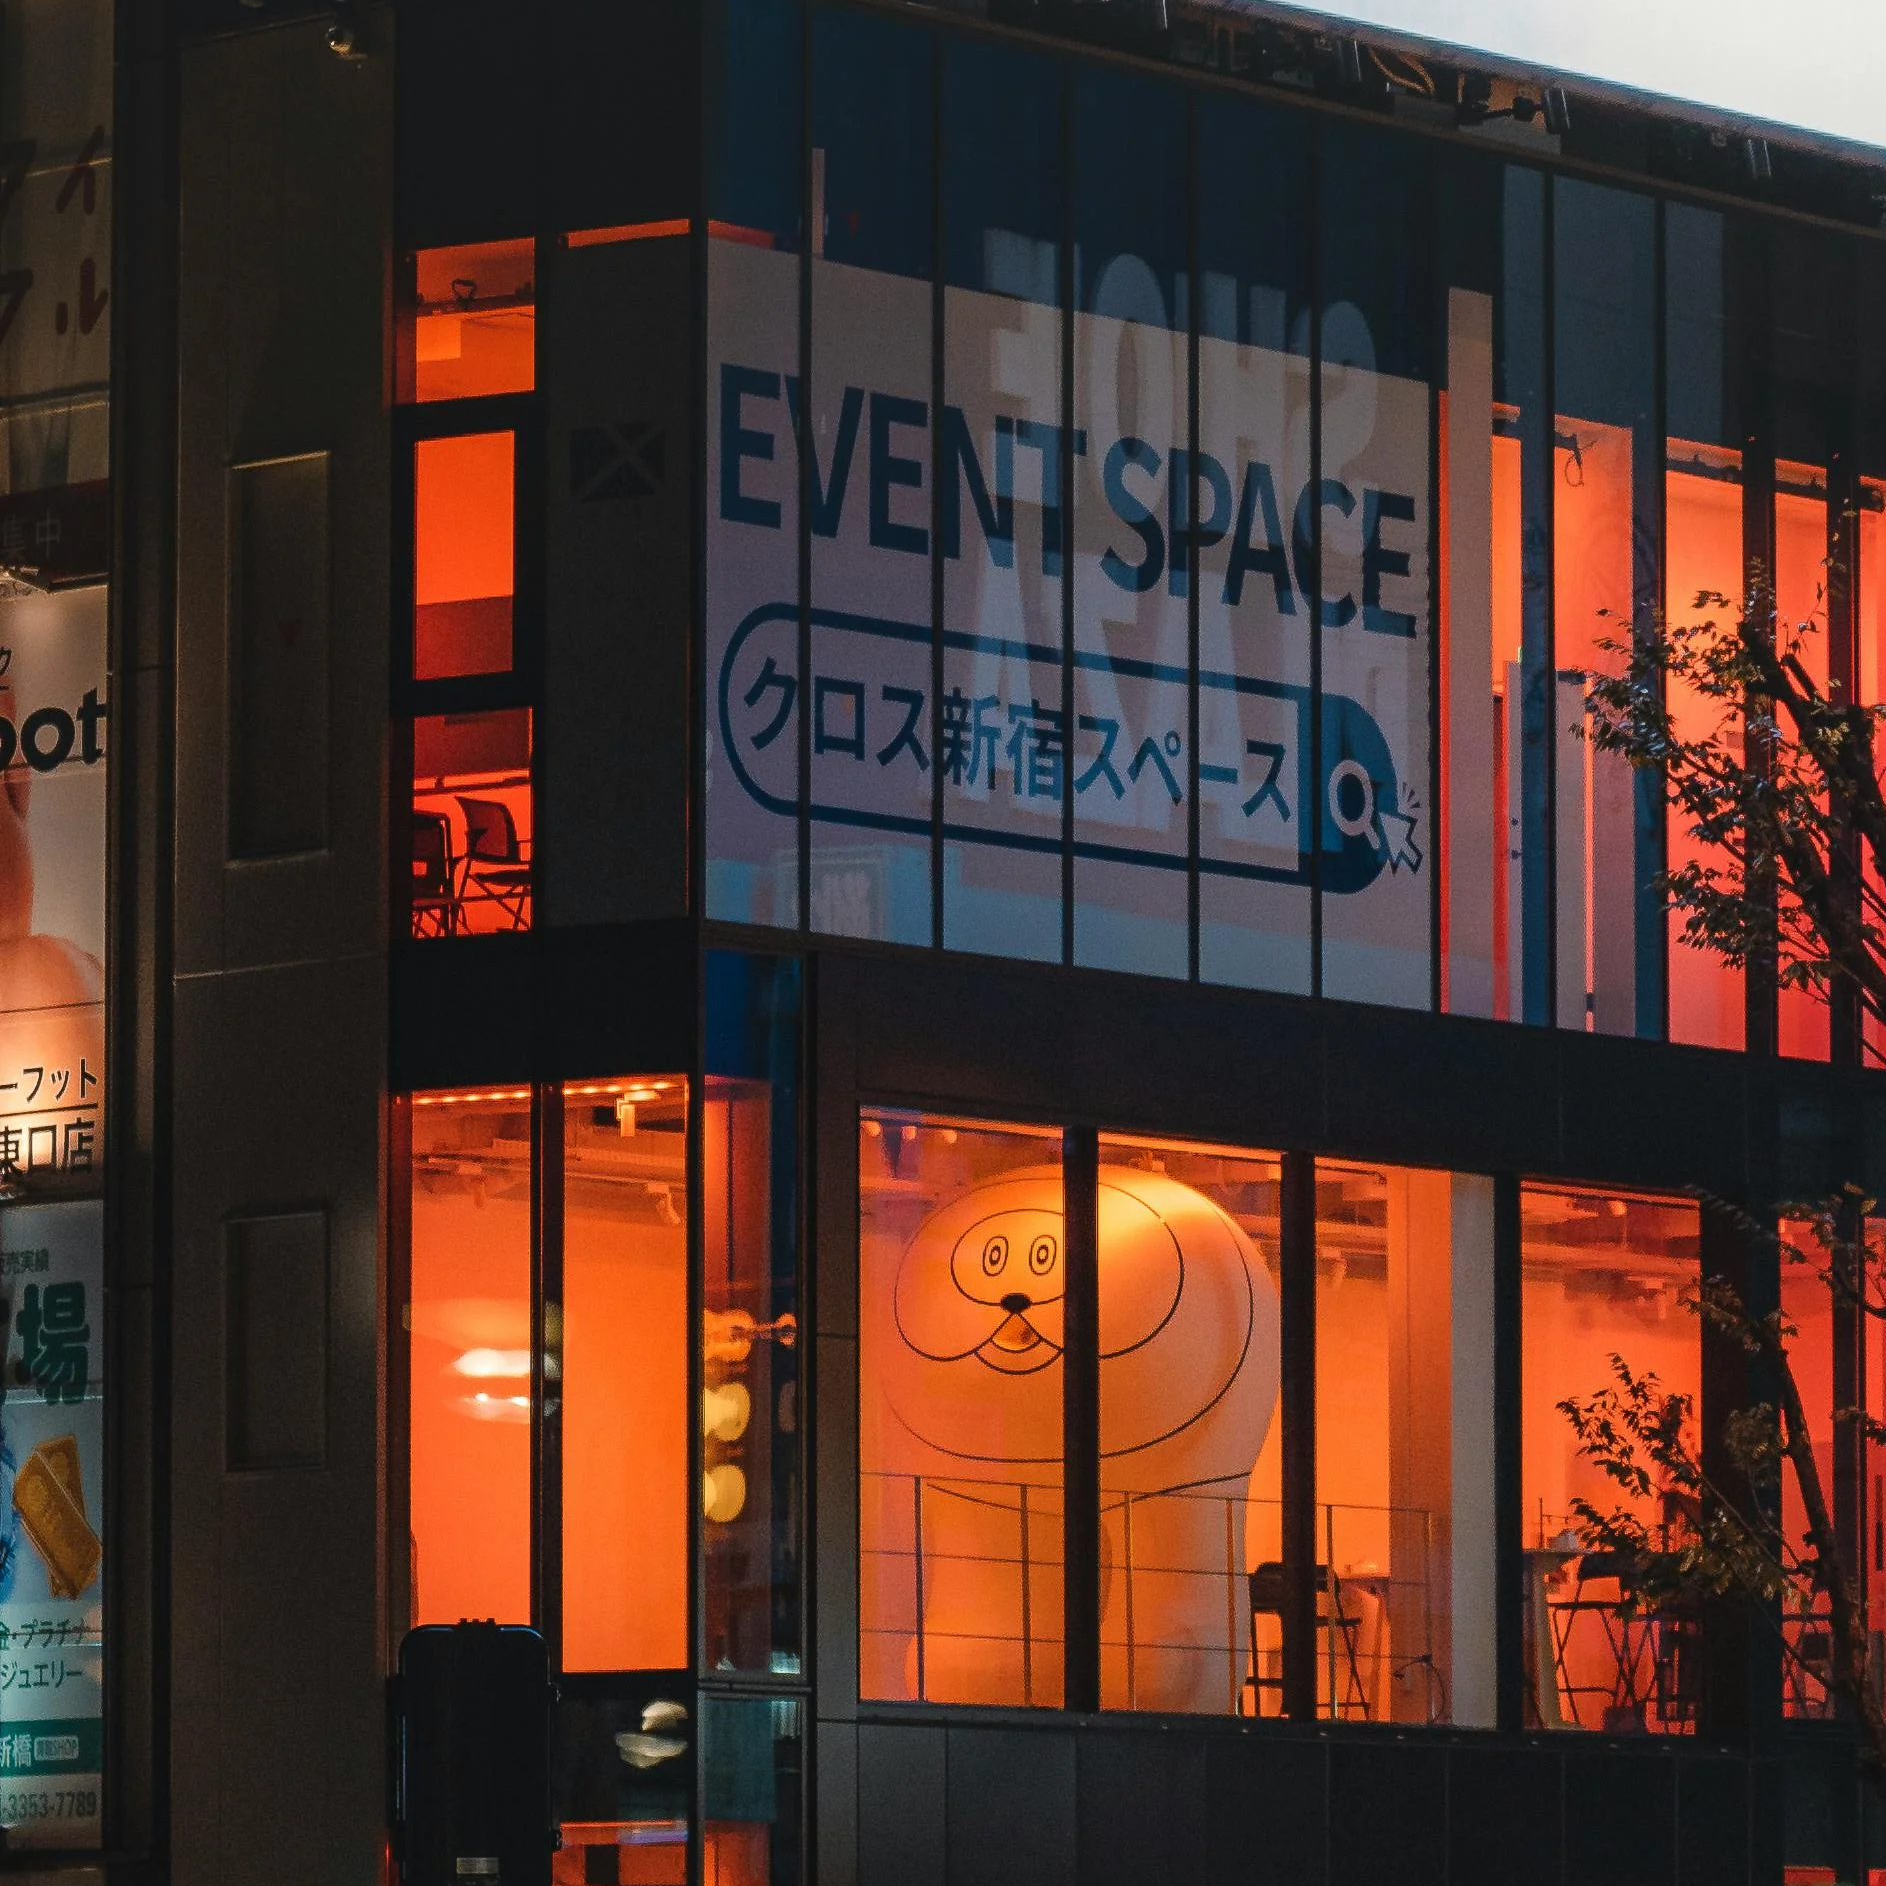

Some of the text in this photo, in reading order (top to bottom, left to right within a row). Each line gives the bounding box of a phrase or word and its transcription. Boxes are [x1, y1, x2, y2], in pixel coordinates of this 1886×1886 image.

[719, 363, 1417, 640] EVENT SPACE
[742, 656, 1292, 824] クロス新宿スペース
